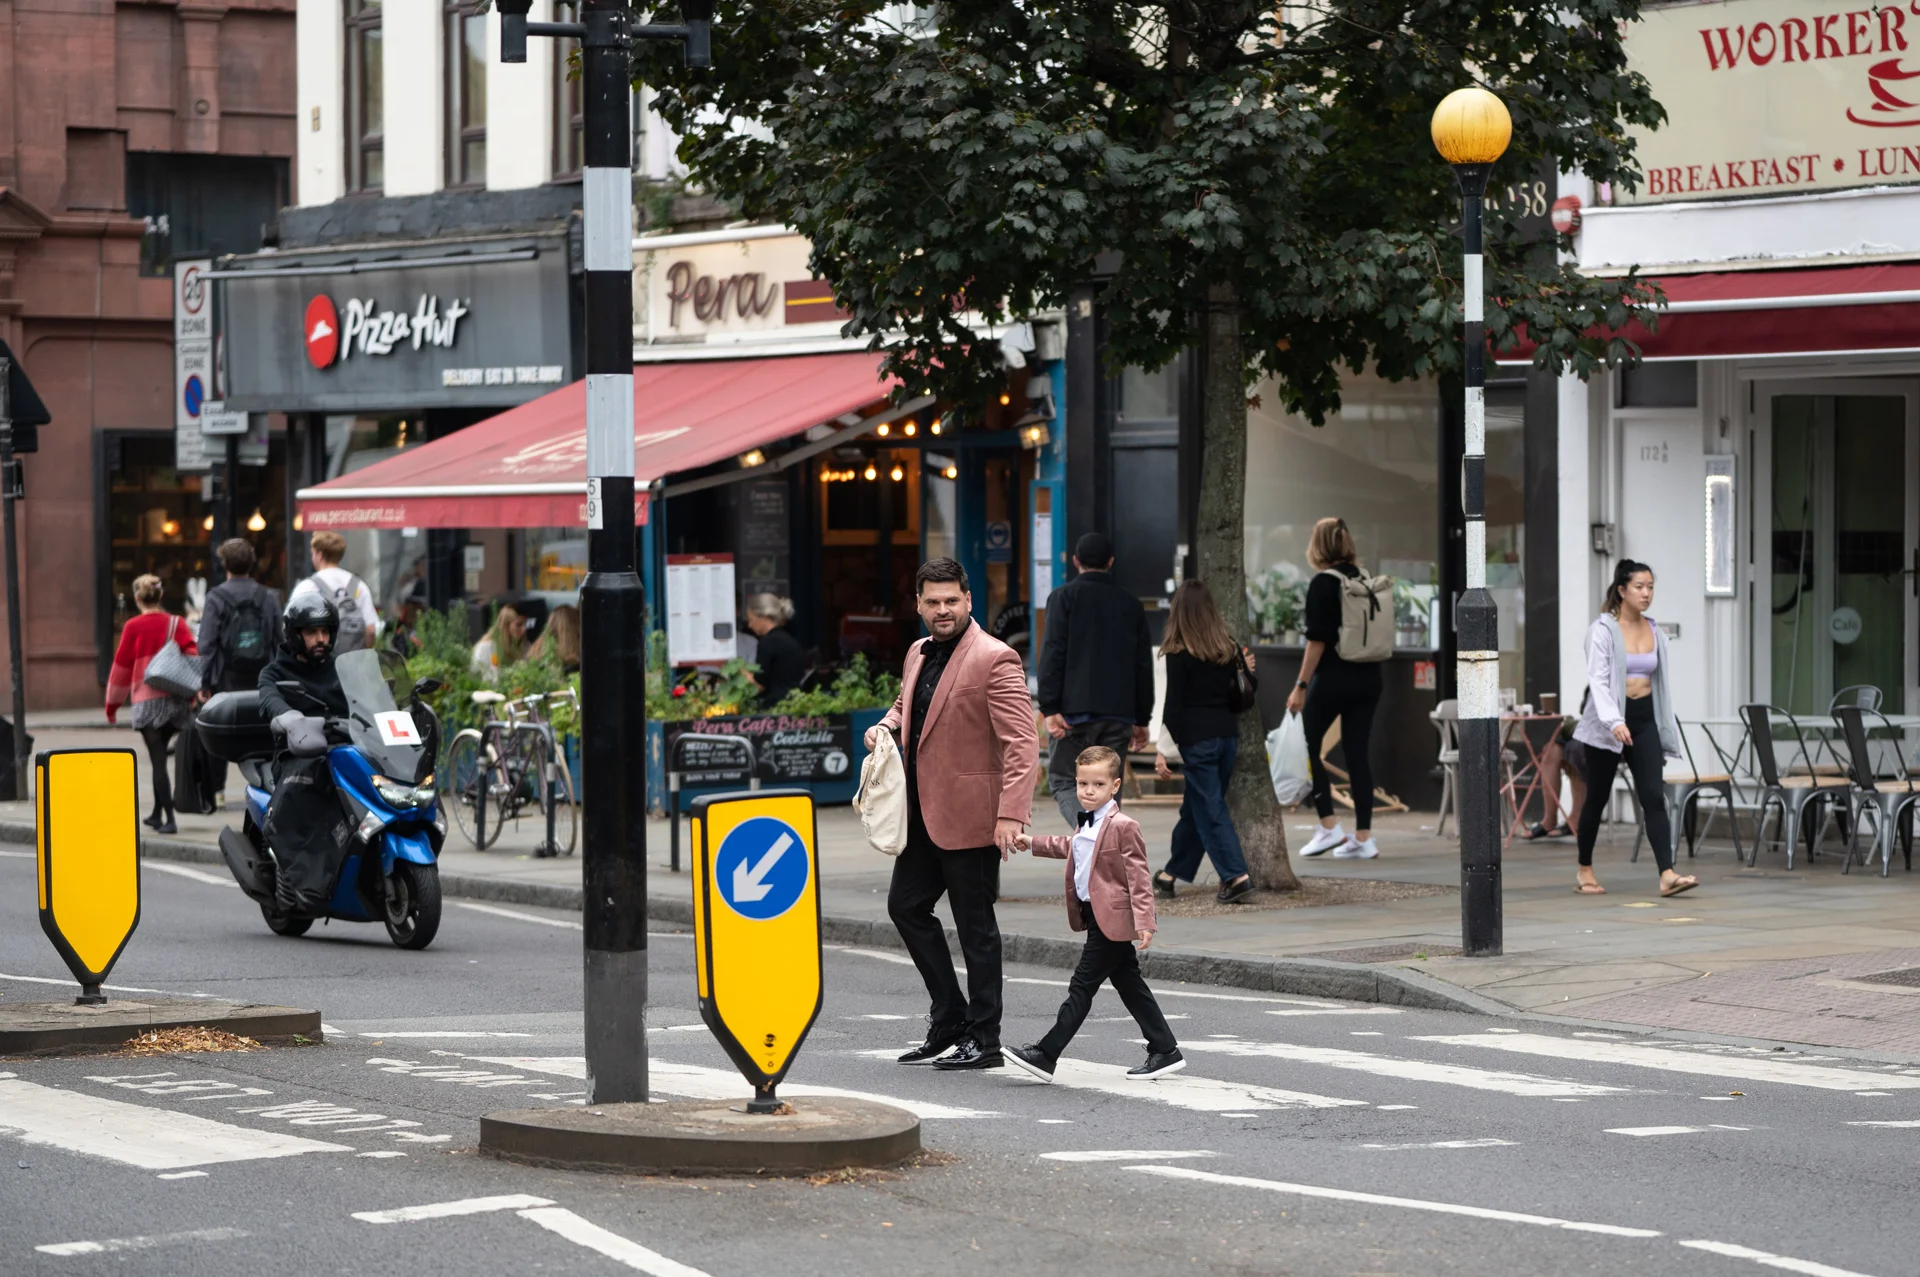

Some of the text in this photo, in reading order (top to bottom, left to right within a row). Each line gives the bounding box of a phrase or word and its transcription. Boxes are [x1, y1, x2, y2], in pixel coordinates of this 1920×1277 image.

[1699, 0, 1920, 71] WORKER
[1648, 154, 1821, 196] BREAKFAST
[666, 260, 779, 331] Pera
[341, 293, 468, 360] Pizza Hut
[387, 720, 410, 738] L
[738, 716, 776, 737] Cafe
